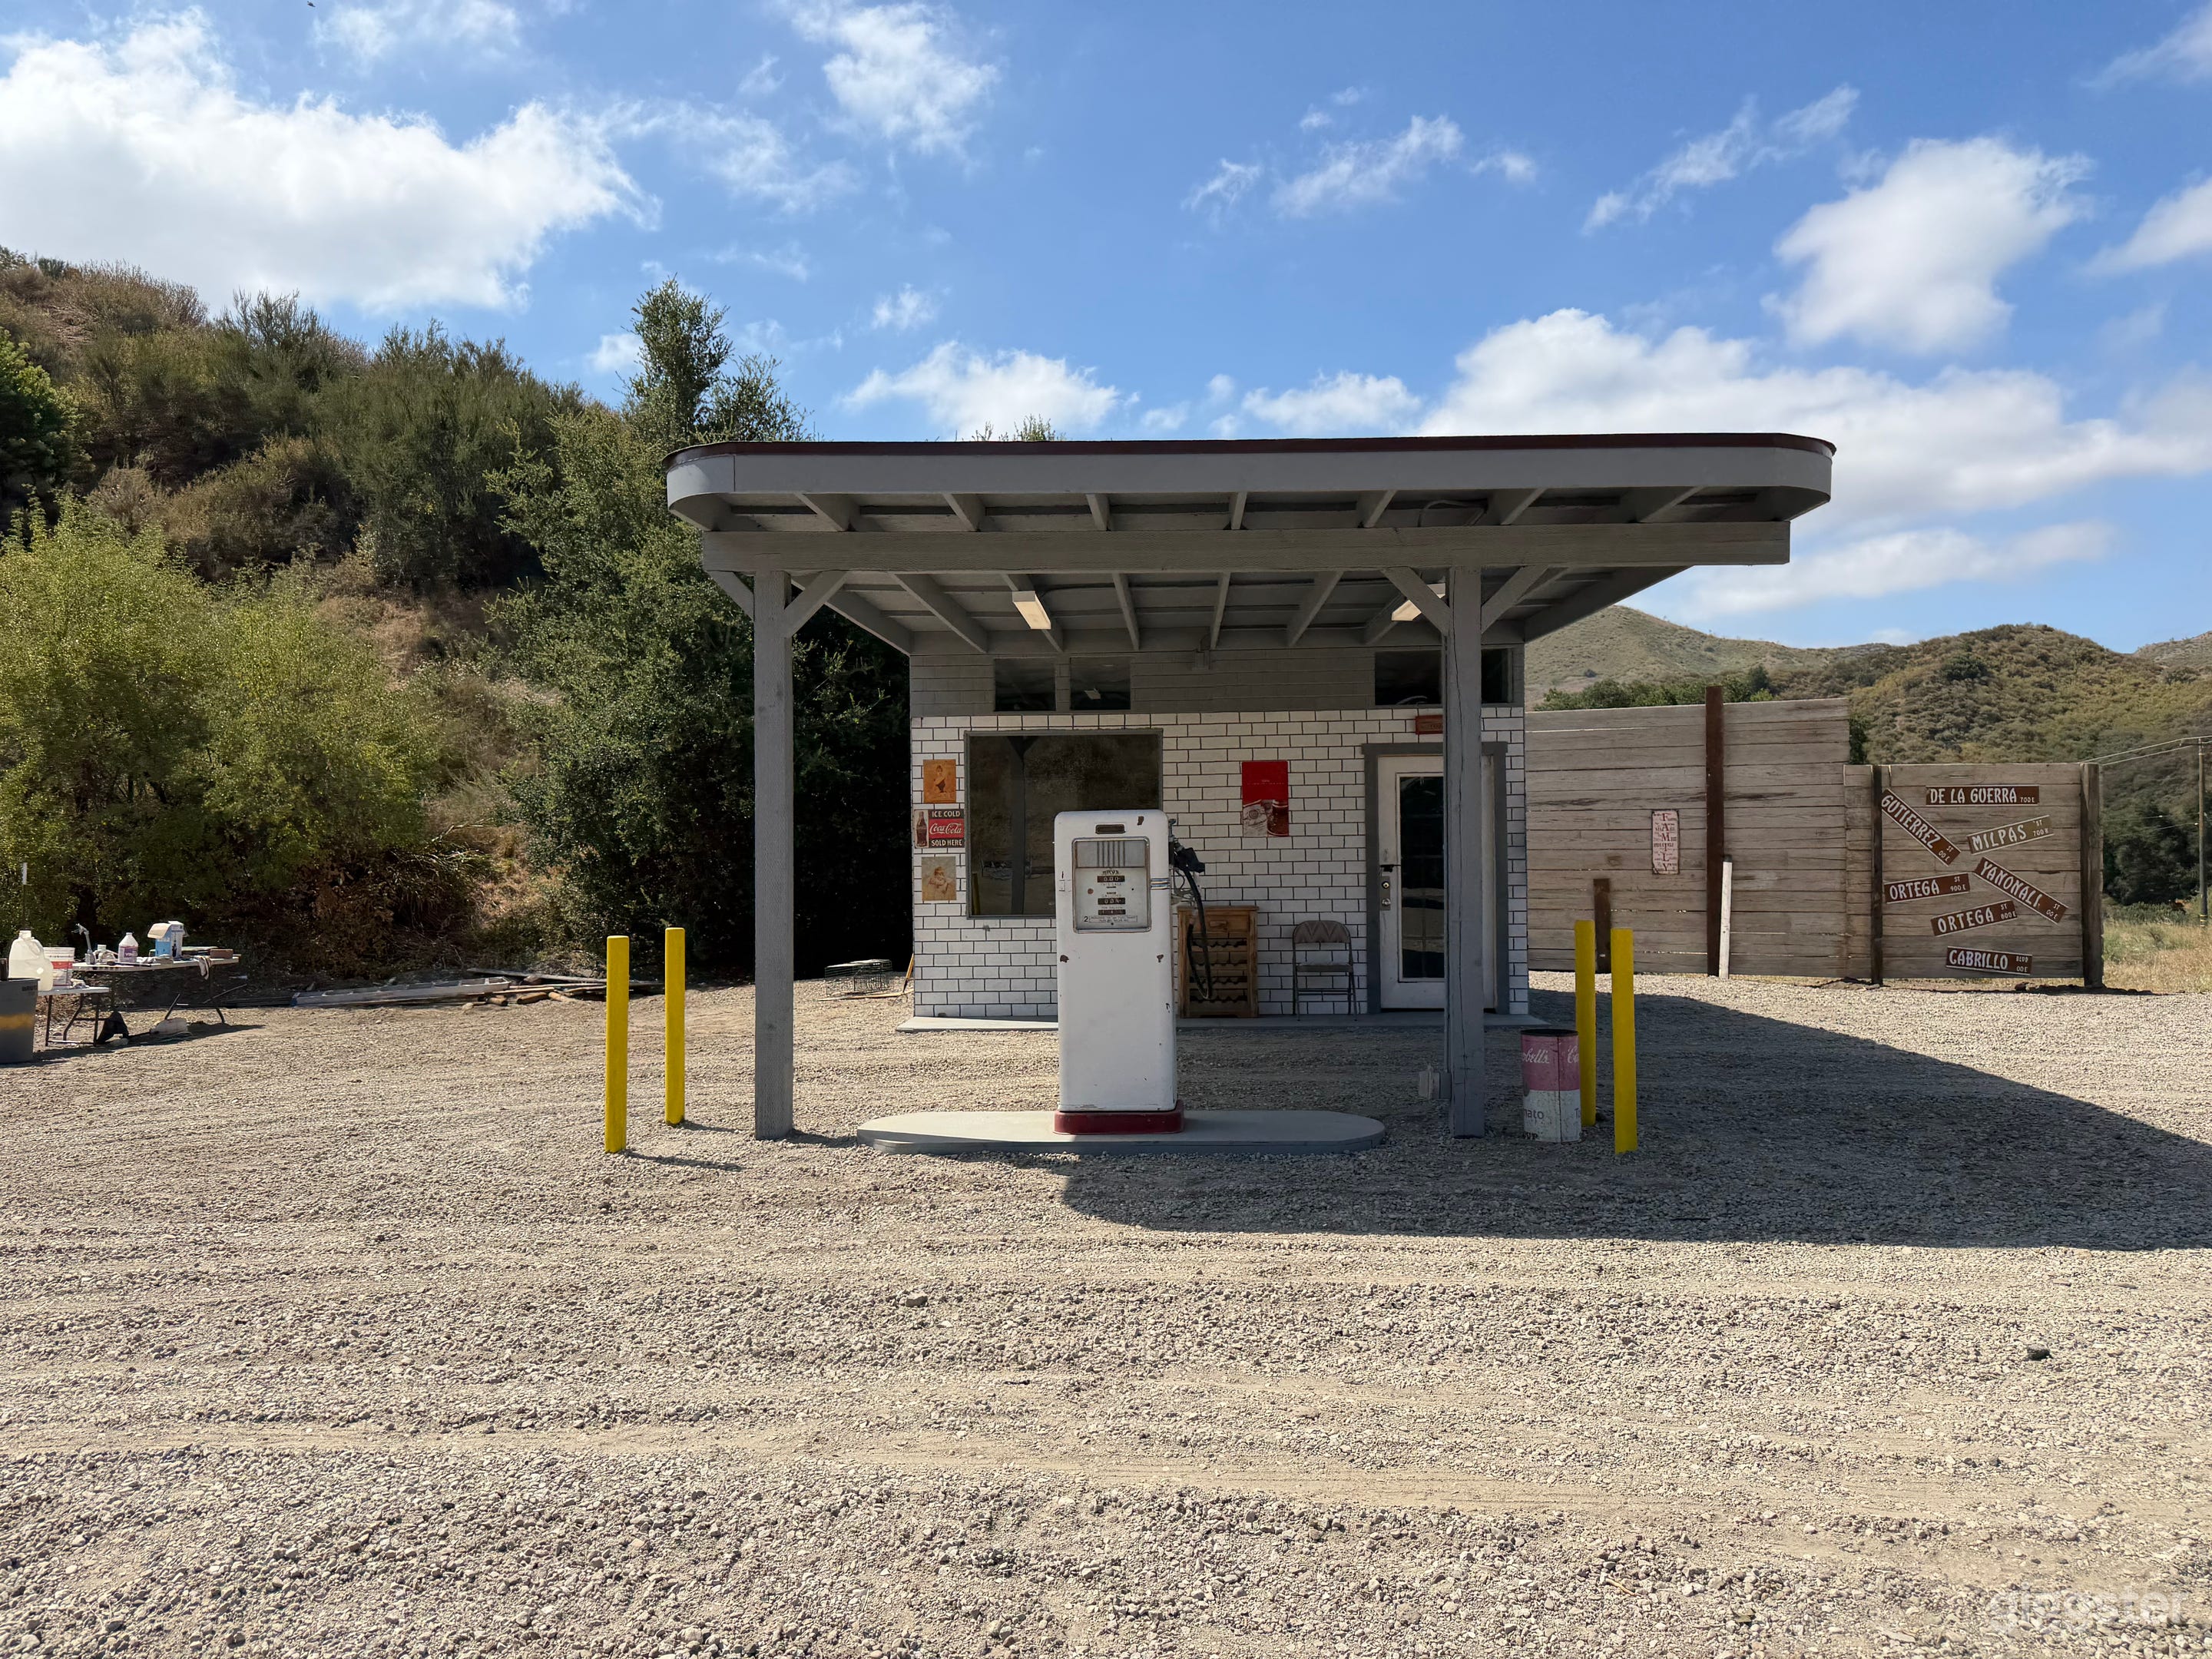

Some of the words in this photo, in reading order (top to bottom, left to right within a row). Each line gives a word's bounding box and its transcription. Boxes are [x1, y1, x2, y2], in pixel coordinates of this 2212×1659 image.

[1930, 788, 1945, 803] DE
[1951, 788, 1965, 803] LA
[1971, 787, 2017, 803] GUERRA
[1881, 795, 1942, 849] GUTIERREZ
[1972, 824, 2027, 851] MILPAS
[2032, 829, 2045, 837] 700
[1946, 845, 1955, 853] ST
[1889, 879, 1940, 900] ORTEGA
[1980, 860, 2043, 908] YANONALI
[1937, 907, 1995, 933] ORTEGA
[1949, 949, 2008, 970] CABRILLO
